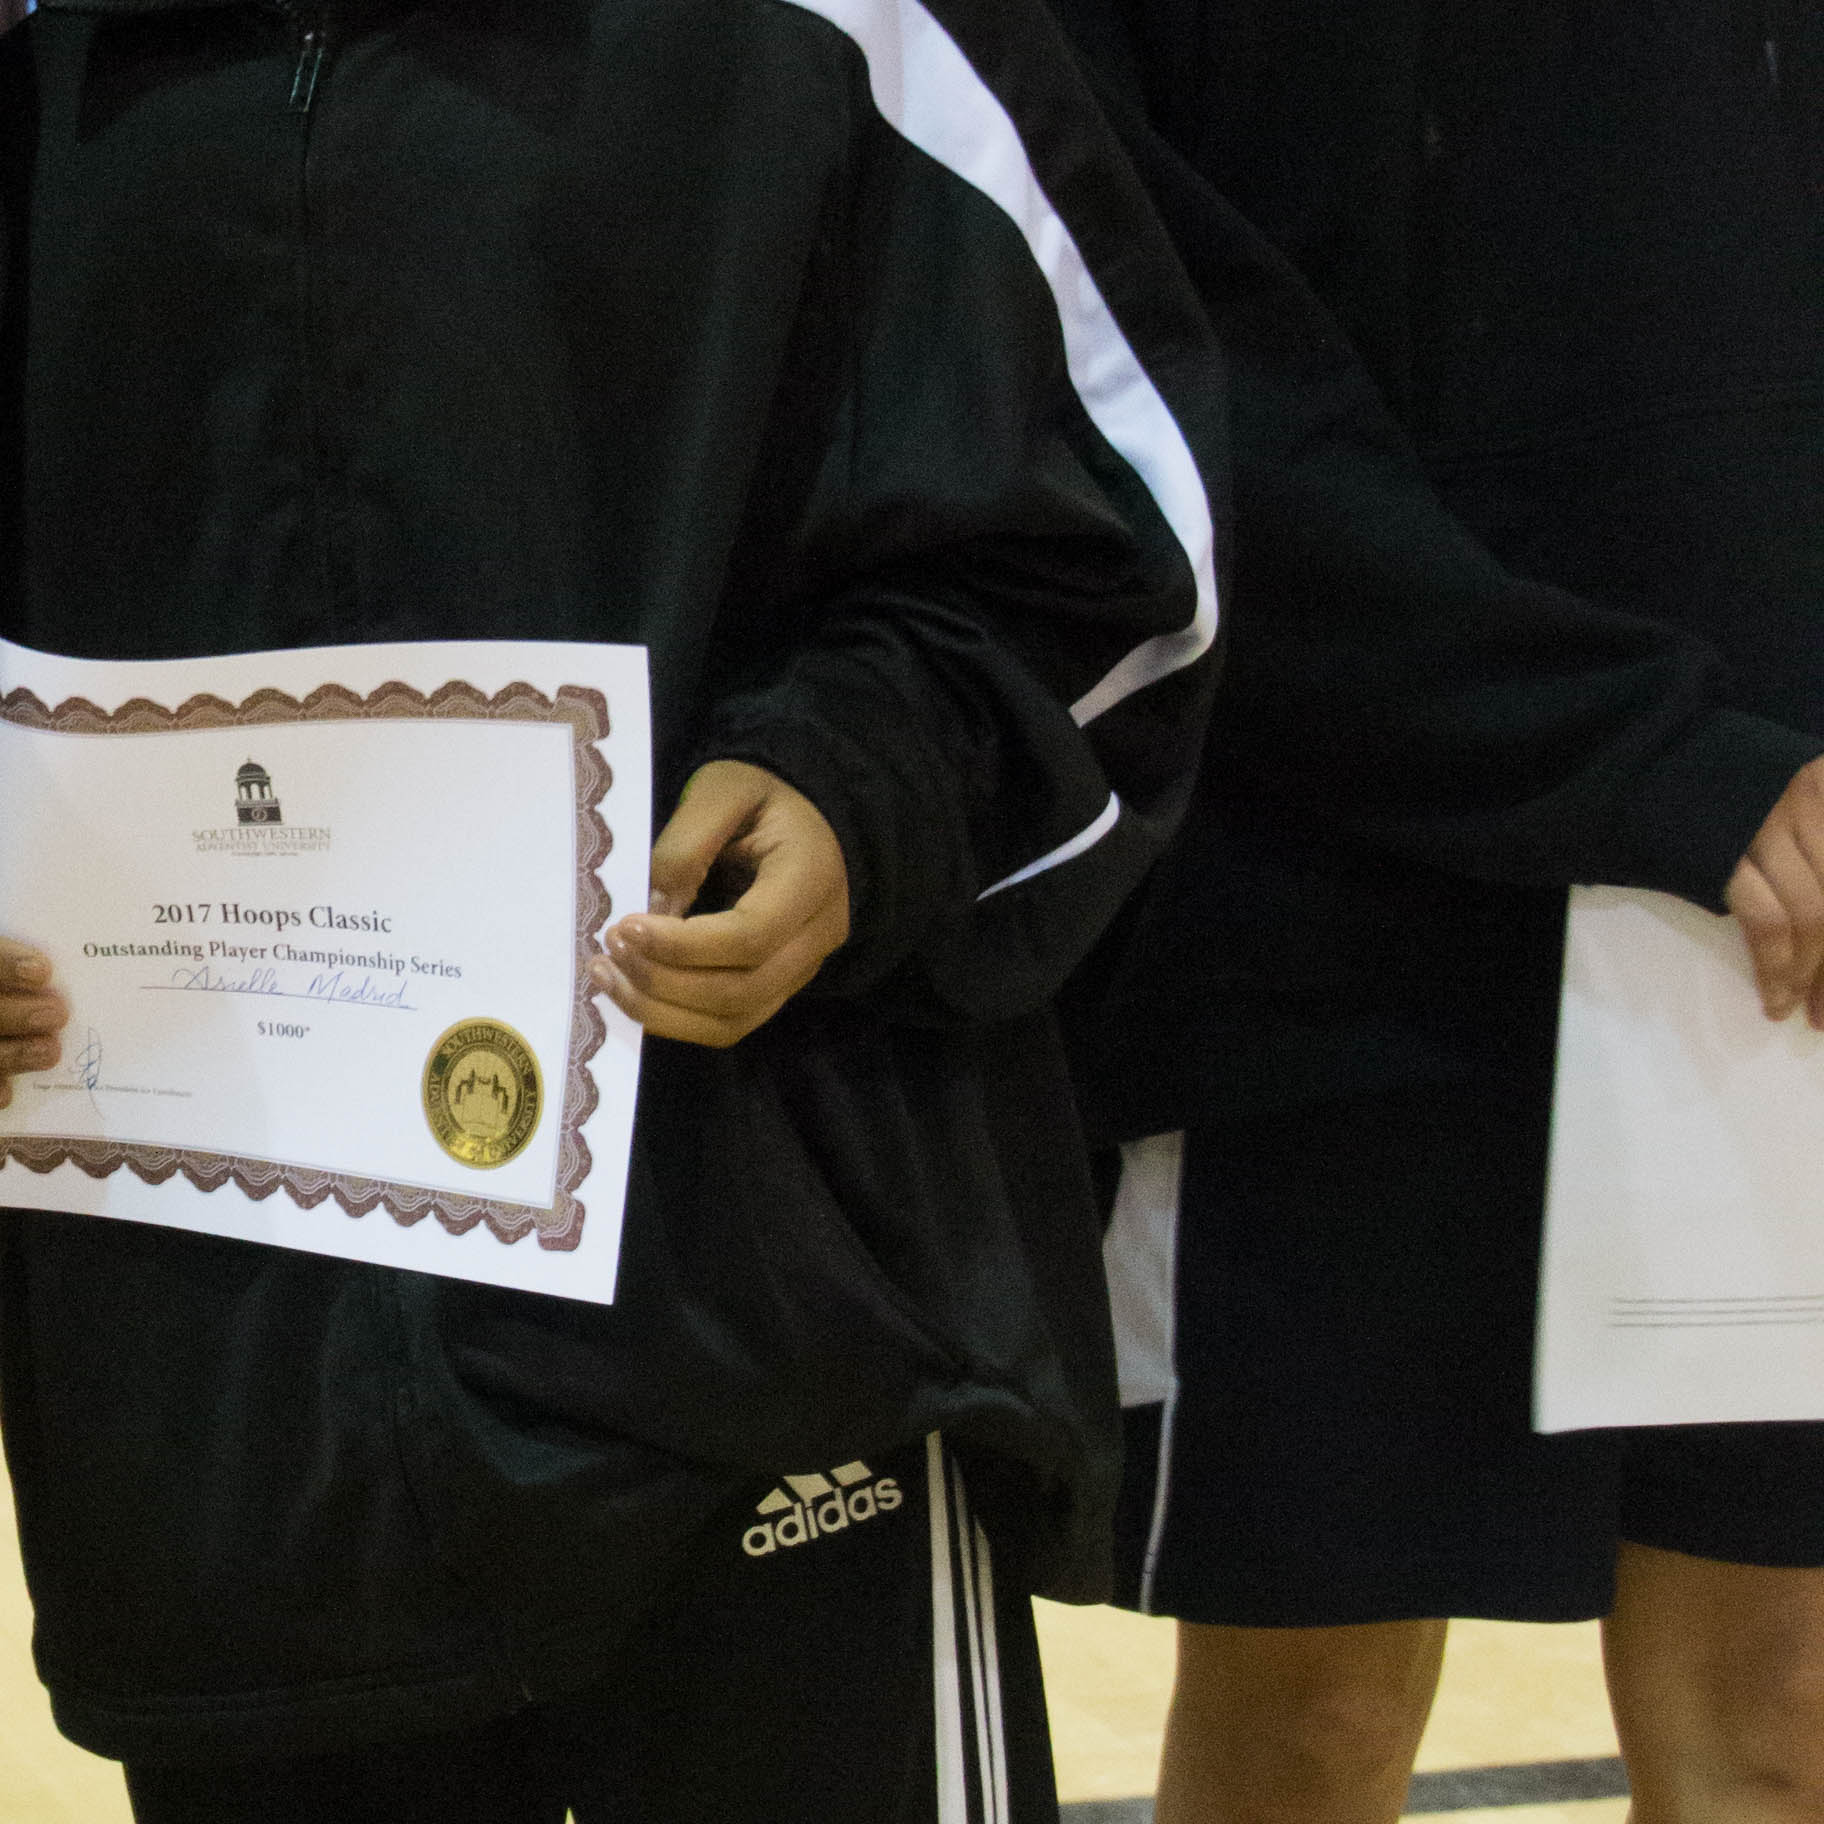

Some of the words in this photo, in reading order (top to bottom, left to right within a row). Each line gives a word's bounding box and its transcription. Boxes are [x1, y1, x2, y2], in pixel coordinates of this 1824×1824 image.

[192, 827, 332, 842] SOUTHWESTERN
[152, 903, 212, 925] 2017
[221, 902, 302, 931] Hoops
[309, 905, 393, 934] Classic
[82, 941, 205, 961] Outstanding
[209, 941, 268, 961] Player
[273, 943, 406, 973] Championship
[410, 956, 463, 979] Series
[741, 1478, 904, 1556] adidas
